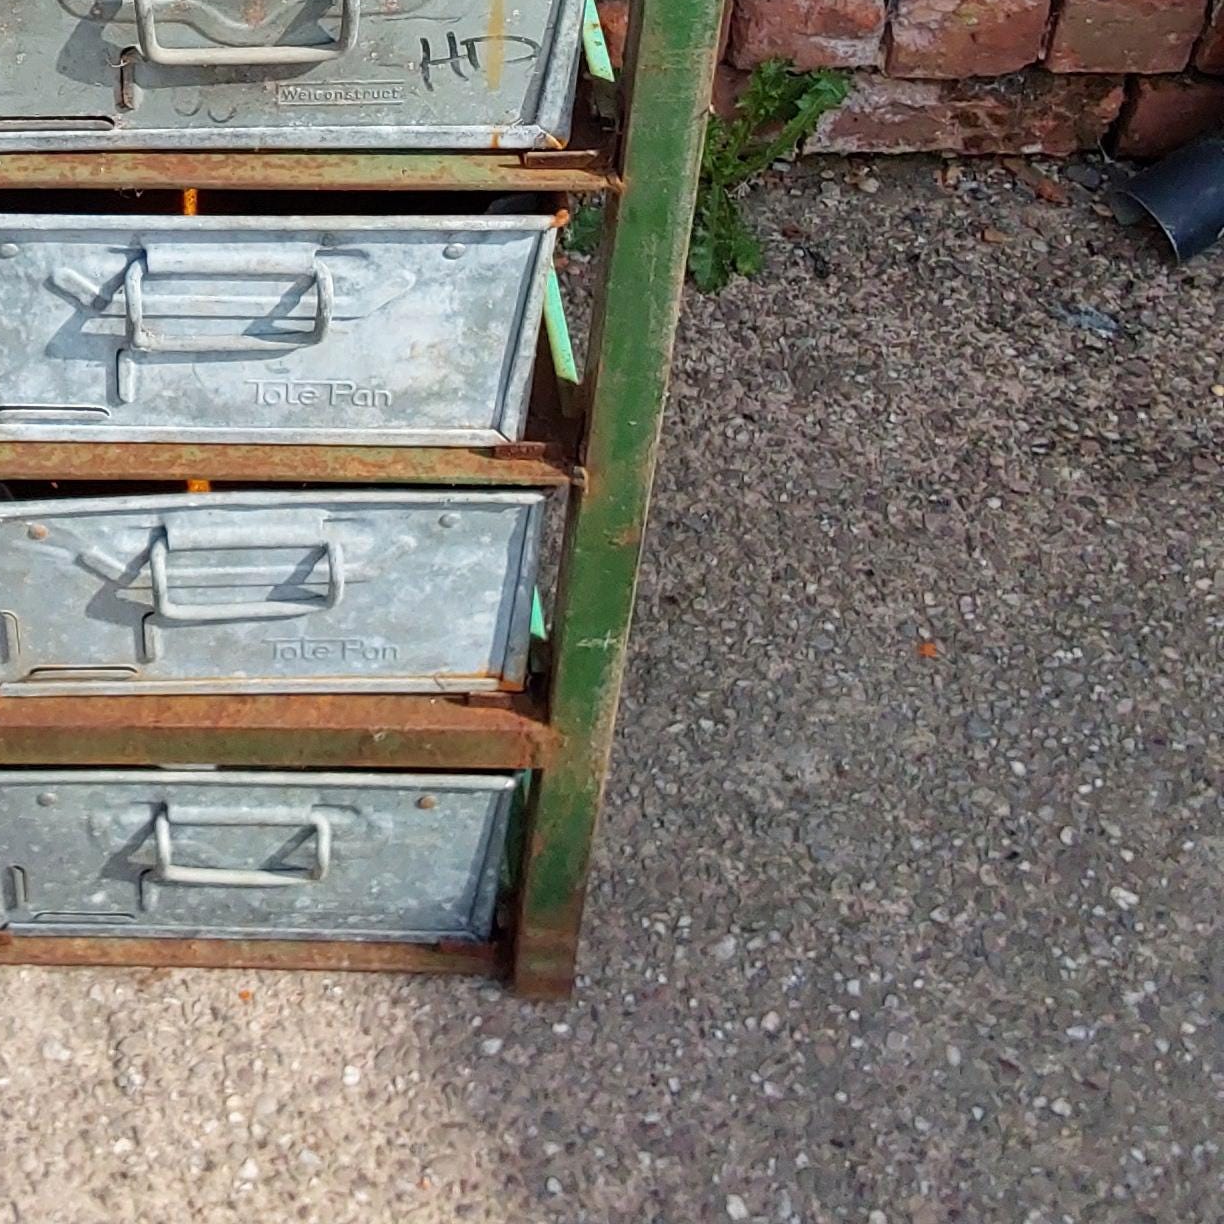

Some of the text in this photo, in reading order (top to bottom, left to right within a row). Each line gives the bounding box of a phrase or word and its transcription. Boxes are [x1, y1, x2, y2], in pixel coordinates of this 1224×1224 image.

[420, 31, 542, 92] HD
[280, 86, 400, 102] Welconstruct
[244, 378, 392, 407] Tote Pan
[260, 636, 398, 661] Tote Pan
